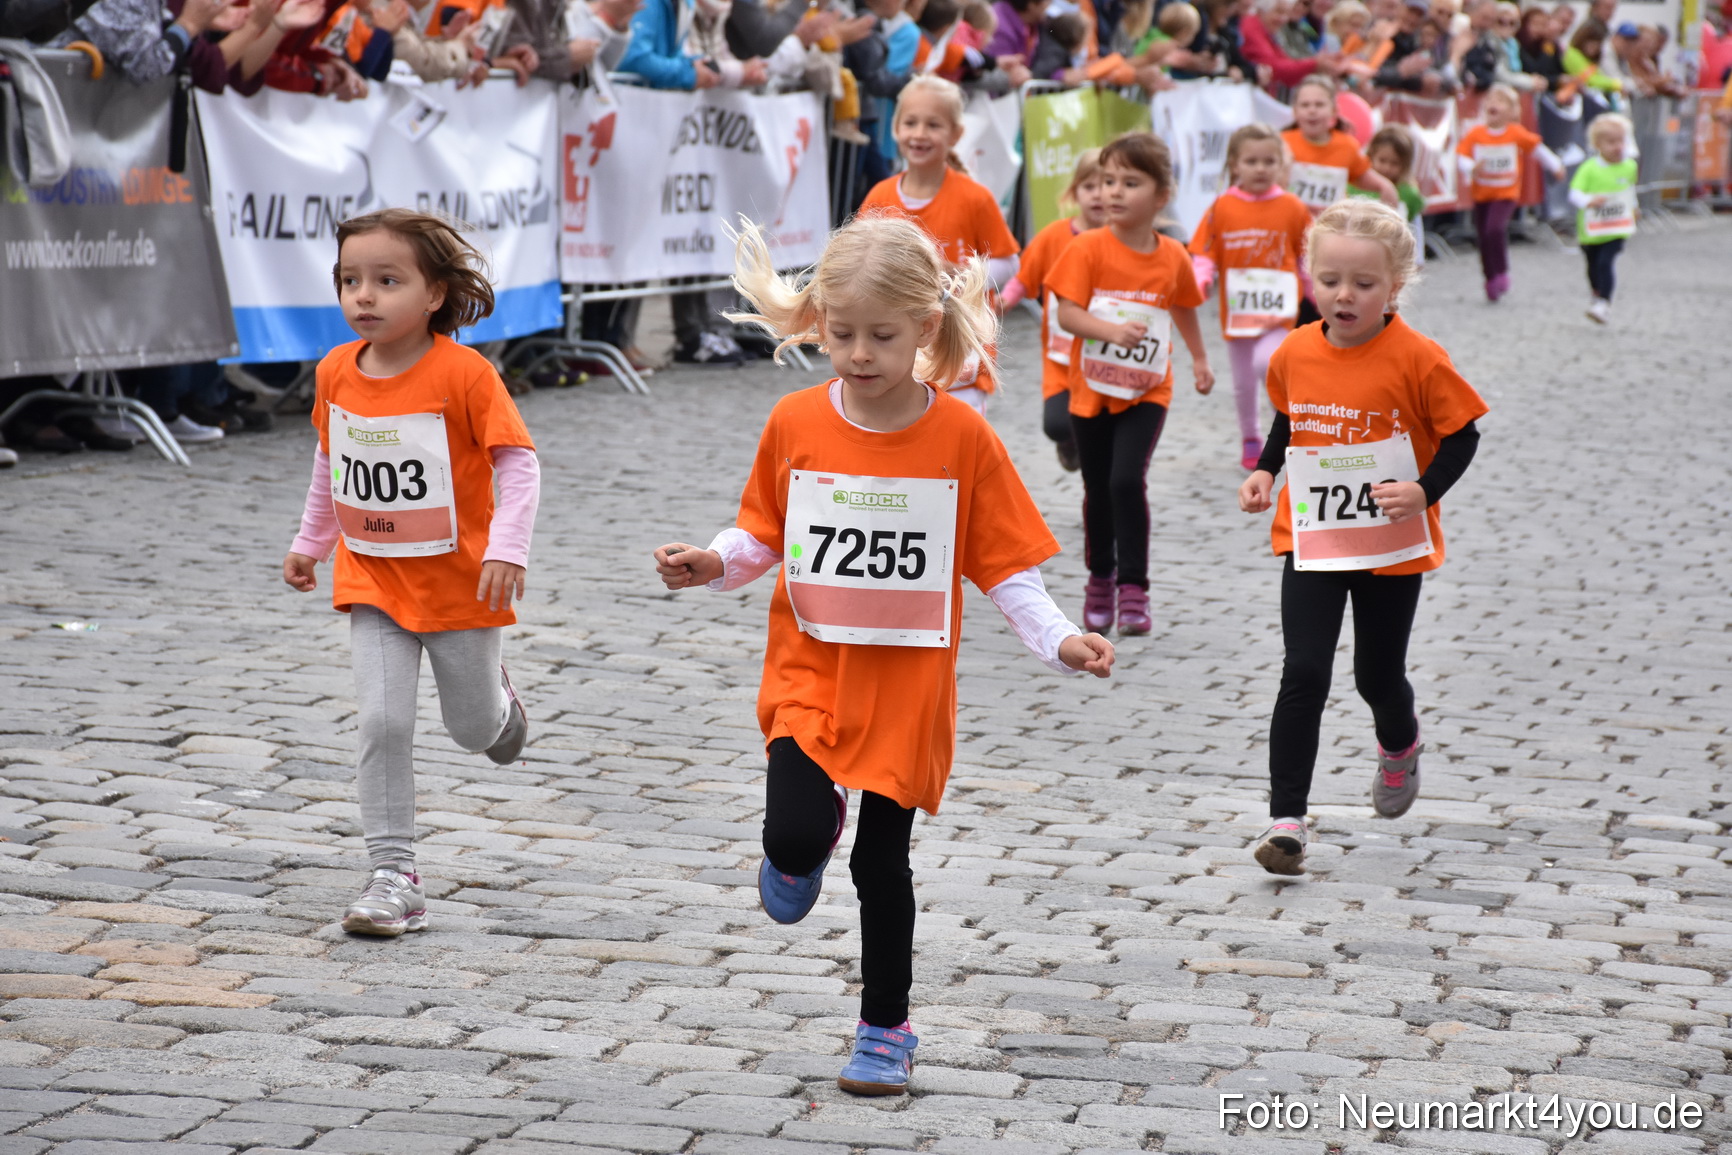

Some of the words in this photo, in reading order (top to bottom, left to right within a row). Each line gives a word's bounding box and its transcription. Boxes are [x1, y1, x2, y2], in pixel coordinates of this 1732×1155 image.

[1238, 290, 1285, 311] 7184
[355, 428, 400, 443] BOCK
[1290, 418, 1343, 438] tadtlauf
[1331, 455, 1376, 469] BOCK
[341, 453, 428, 503] 7003
[849, 491, 908, 508] BOCK
[1309, 478, 1399, 522] 724
[363, 516, 396, 534] Julia
[808, 524, 927, 580] 7255
[883, 1031, 905, 1043] LICO
